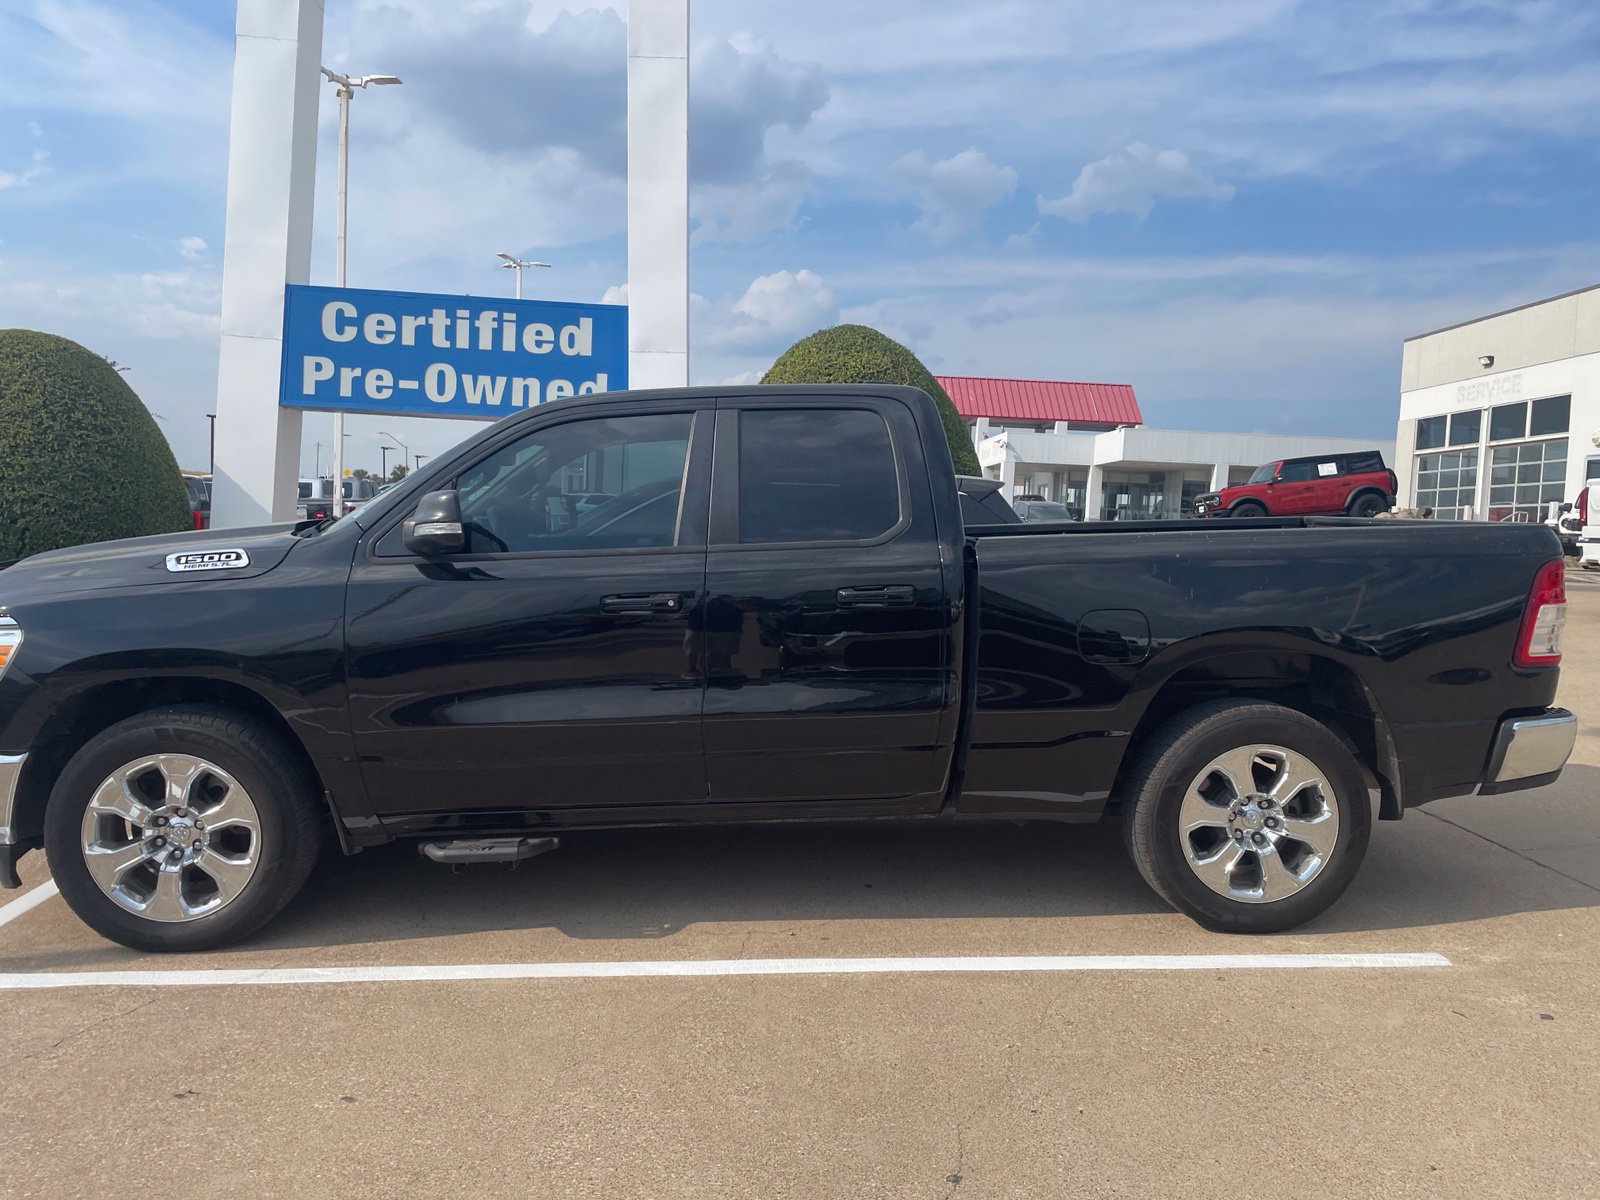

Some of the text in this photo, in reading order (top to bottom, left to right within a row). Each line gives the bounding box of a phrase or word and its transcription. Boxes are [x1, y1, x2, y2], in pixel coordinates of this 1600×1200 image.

[321, 301, 593, 357] Certified
[1457, 374, 1523, 403] SERVICE
[180, 553, 237, 564] 1500
